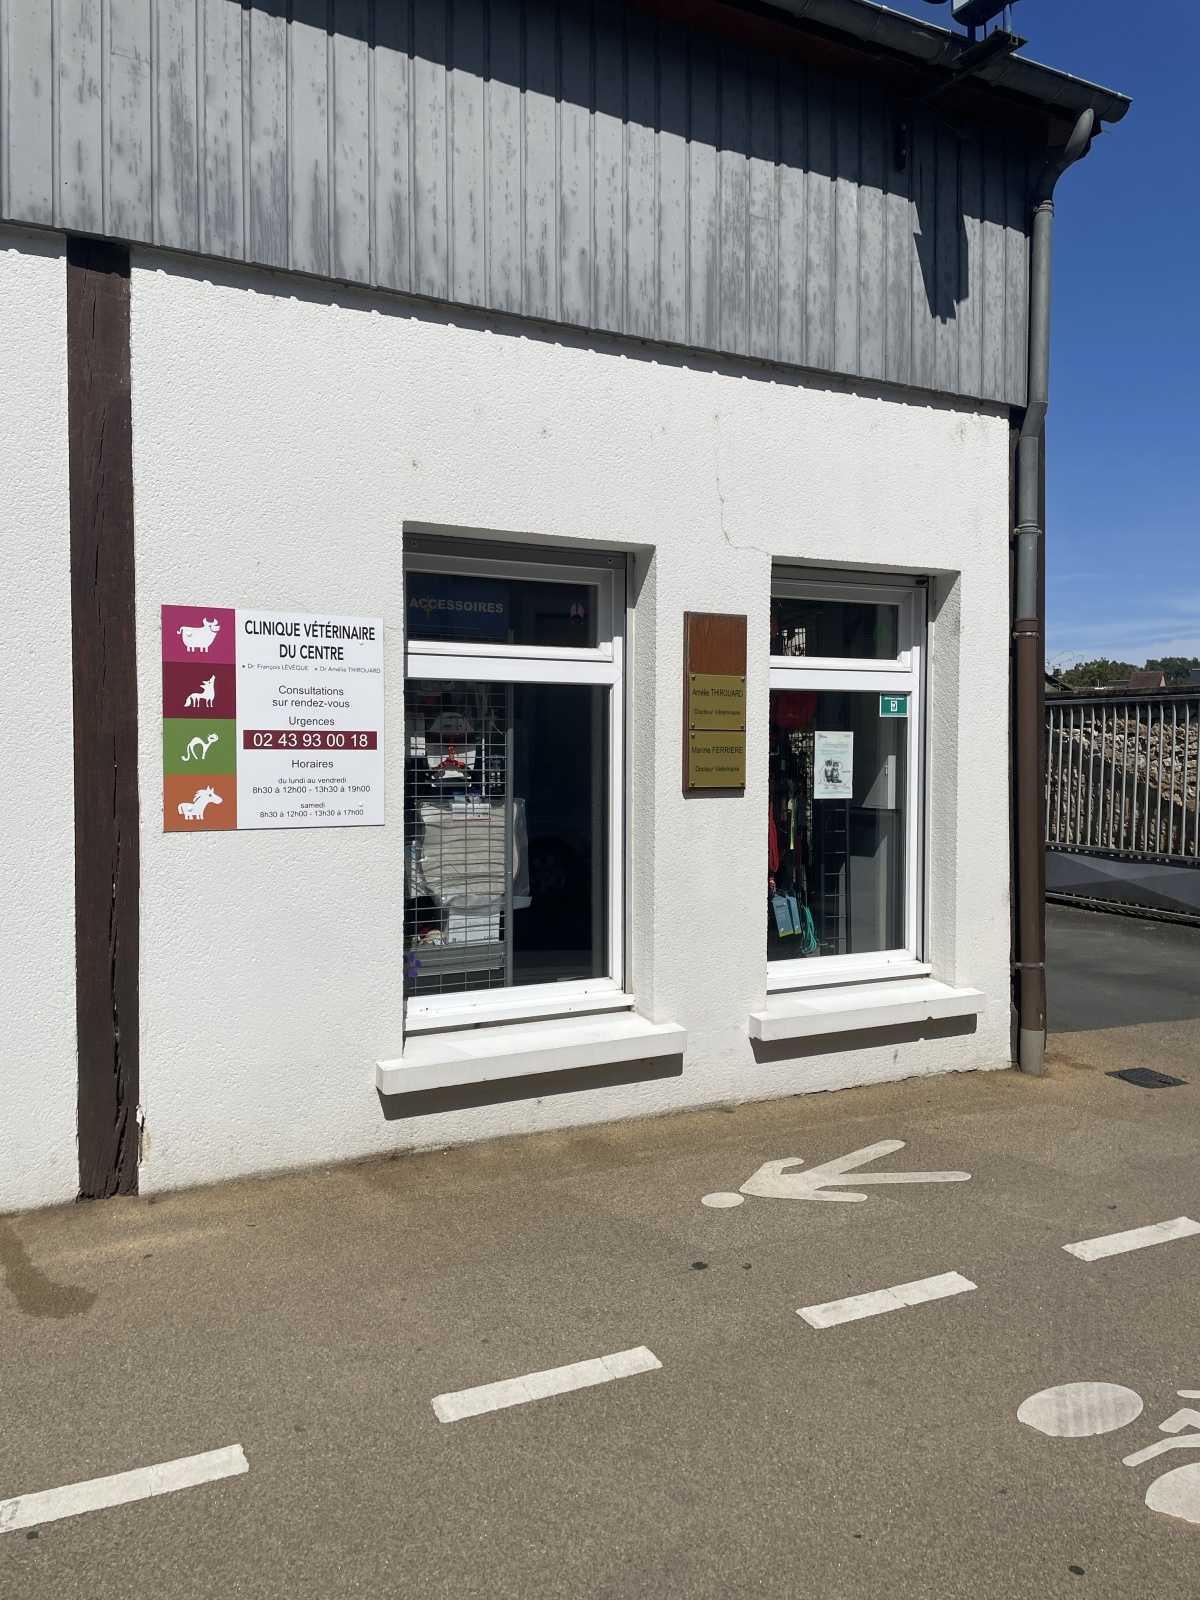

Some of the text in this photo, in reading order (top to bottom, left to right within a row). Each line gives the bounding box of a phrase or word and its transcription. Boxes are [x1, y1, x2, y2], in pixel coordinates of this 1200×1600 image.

[409, 597, 504, 614] ACCESSOIRES
[244, 620, 376, 641] CLINIQUE VÉTÉRINAIRE
[279, 644, 344, 661] DU CENTRE
[278, 685, 345, 696] Consultations
[272, 698, 351, 708] sur rendez-vous
[288, 716, 335, 727] Urgences
[253, 733, 368, 748] 02 43 93 00 18
[291, 759, 334, 769] Horaires
[252, 786, 273, 794] 8h30
[348, 785, 371, 793] 19h00
[300, 801, 326, 809] samedi
